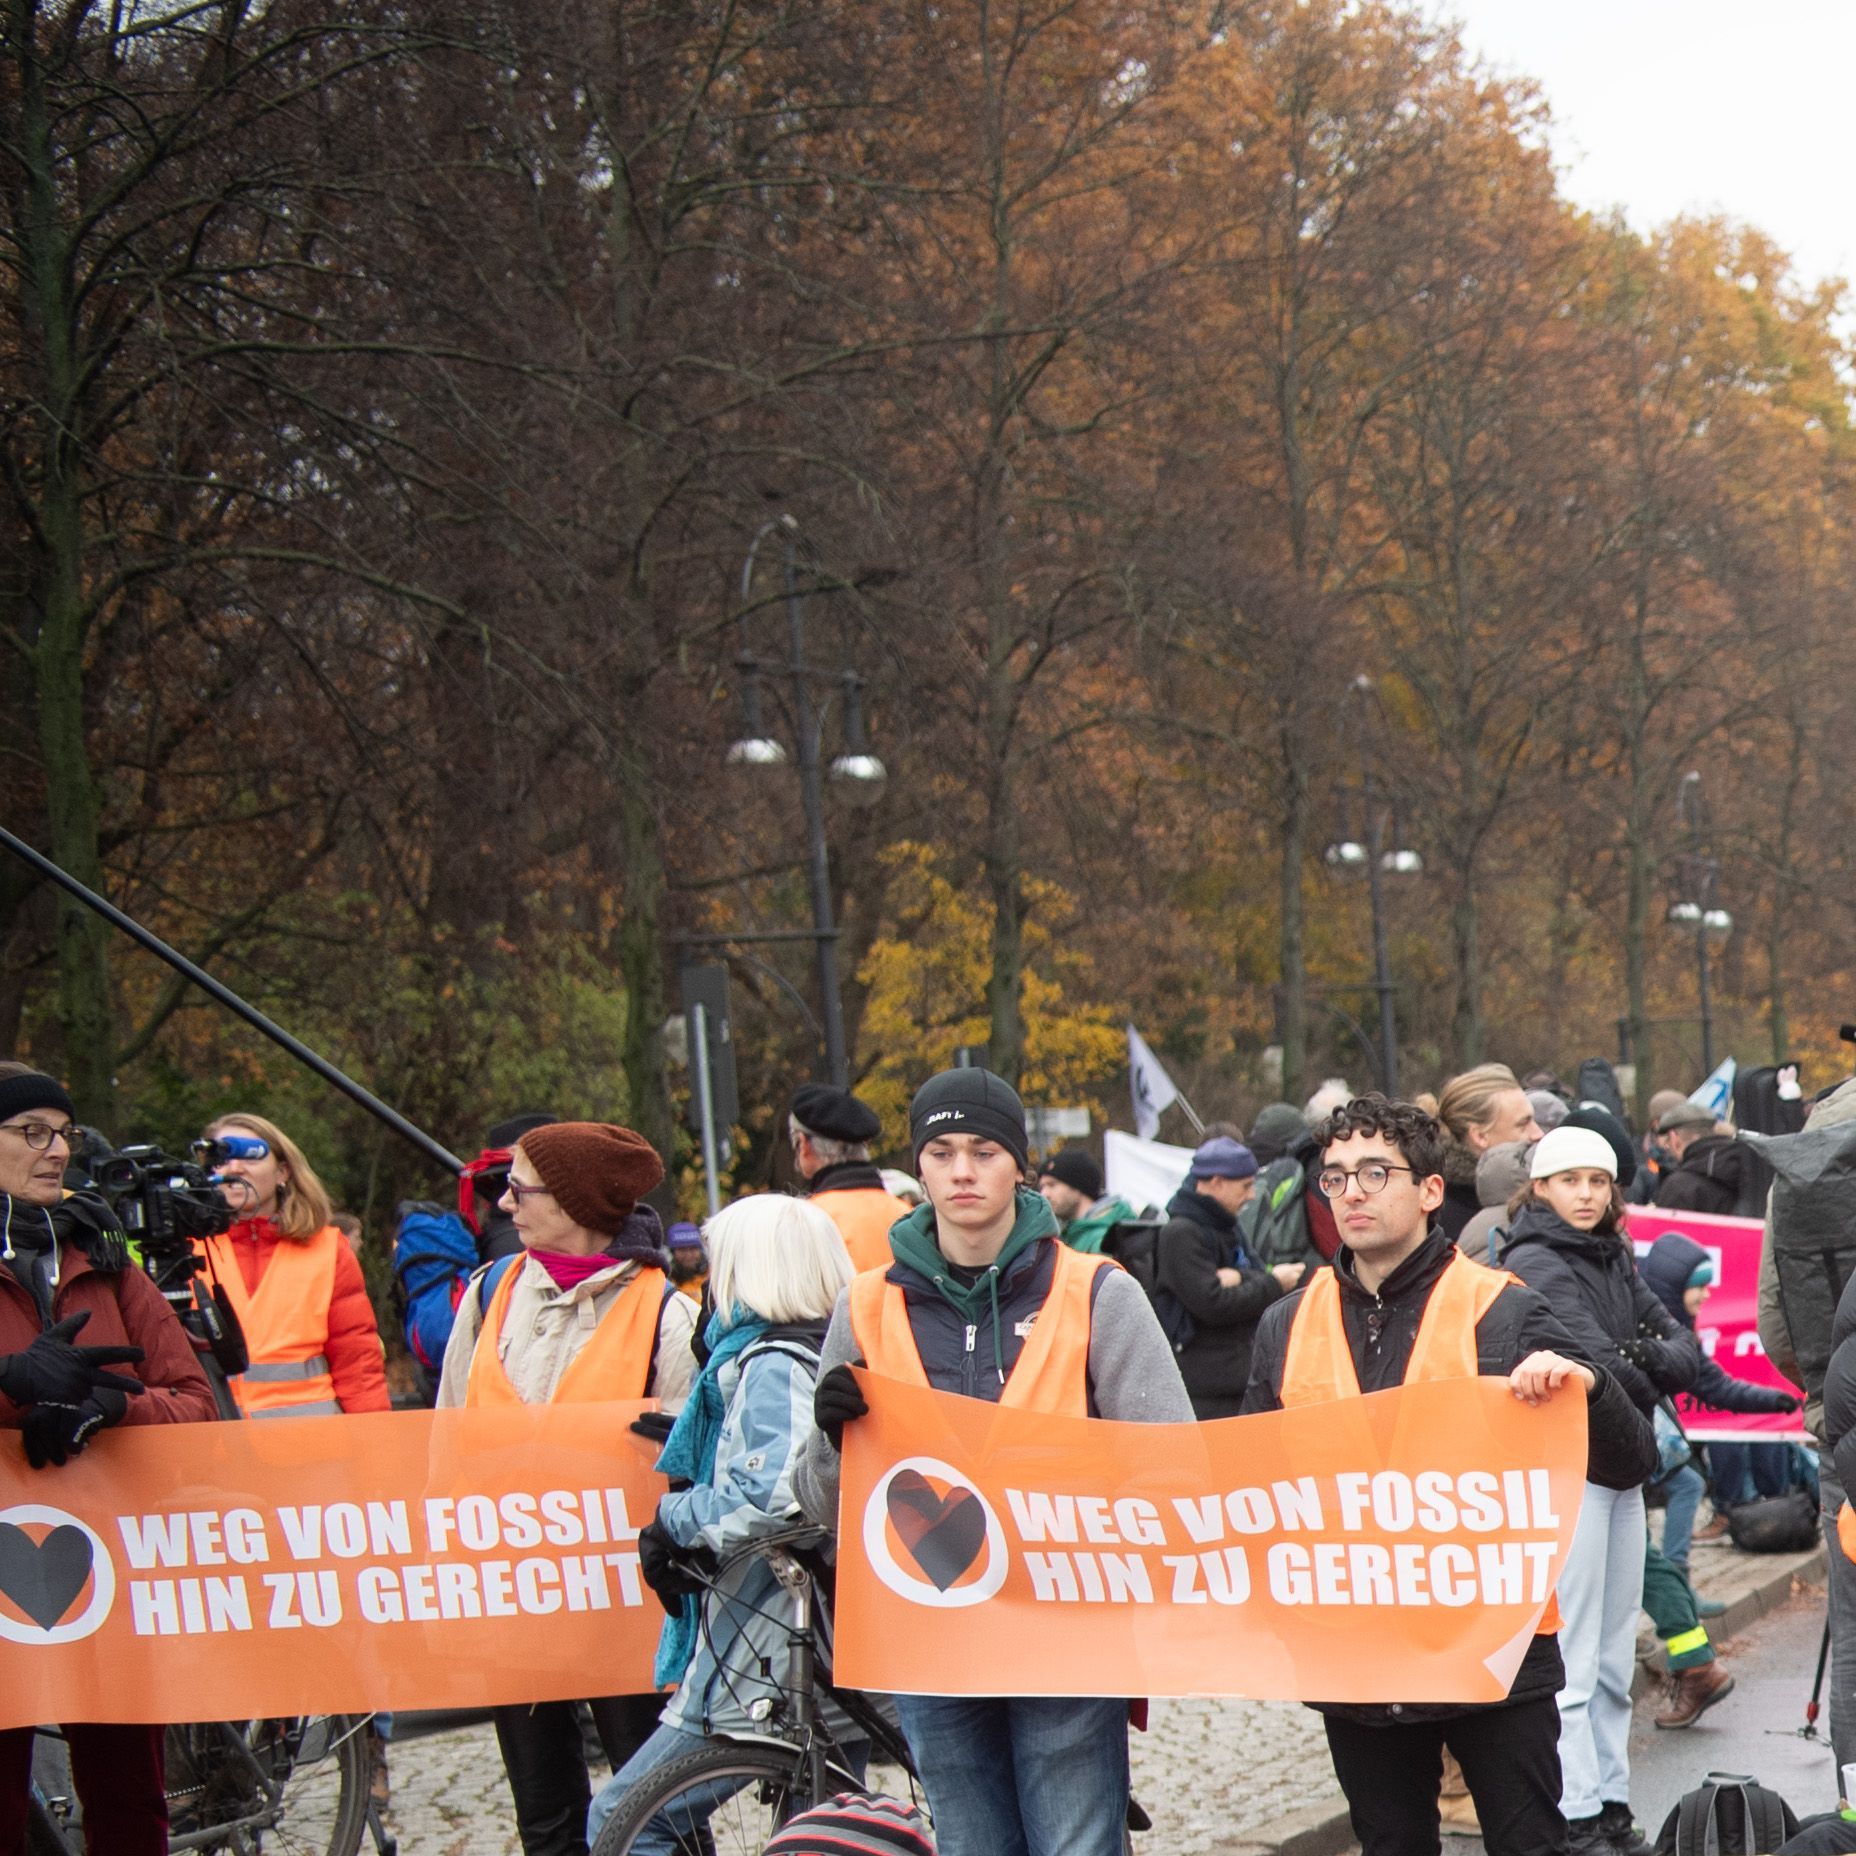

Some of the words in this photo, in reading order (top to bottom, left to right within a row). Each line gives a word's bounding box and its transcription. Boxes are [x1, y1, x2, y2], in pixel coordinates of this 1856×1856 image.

[117, 1508, 269, 1569] WEG
[278, 1500, 411, 1561] VON
[426, 1489, 640, 1552] FOSSIL
[1005, 1489, 1166, 1547] WEG
[1173, 1484, 1326, 1543] VON
[1336, 1468, 1559, 1531] FOSSIL
[131, 1573, 252, 1636] HIN
[264, 1568, 343, 1629] ZU
[359, 1552, 645, 1623] GERECHT
[1024, 1550, 1154, 1603] HIN
[1162, 1545, 1251, 1605] ZU
[1266, 1540, 1559, 1607] GERECHT
